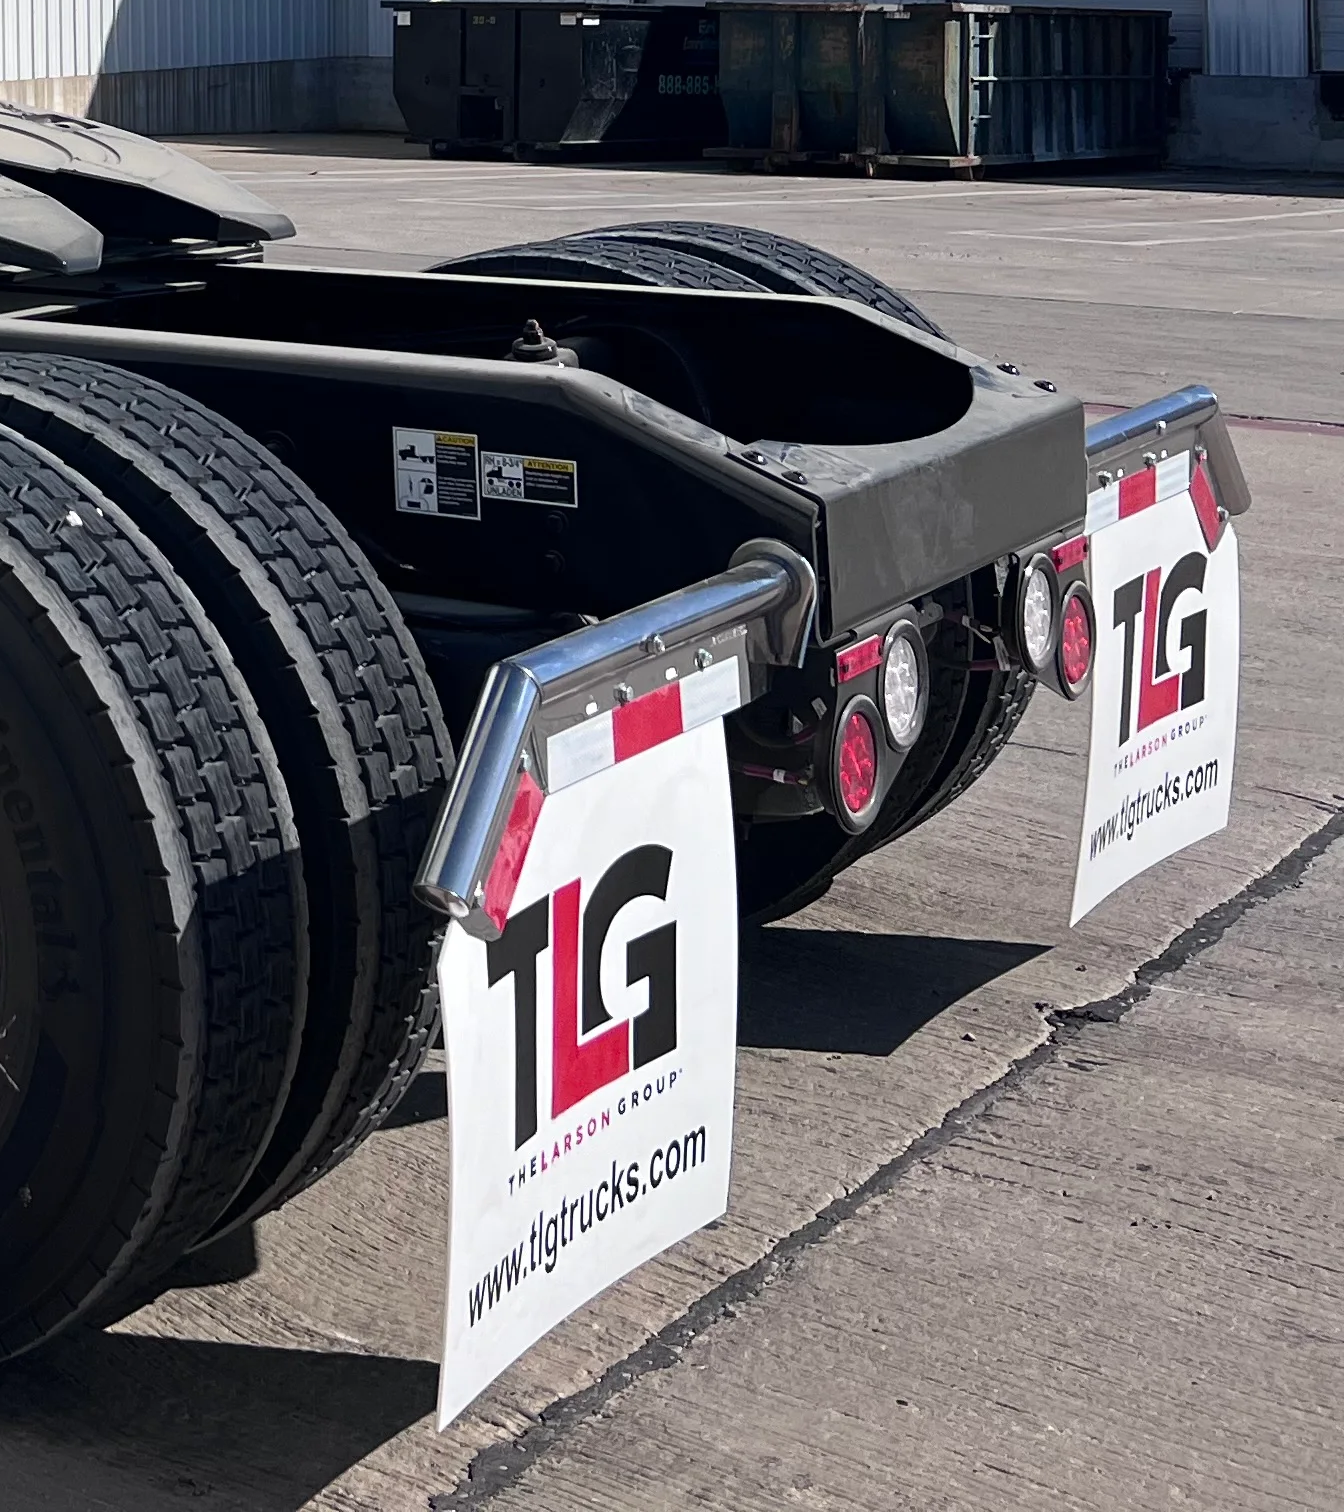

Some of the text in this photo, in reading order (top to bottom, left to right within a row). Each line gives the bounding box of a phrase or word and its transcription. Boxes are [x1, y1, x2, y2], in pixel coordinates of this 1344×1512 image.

[487, 487, 522, 497] UNLADEN
[527, 462, 569, 470] ATTENTION
[1113, 551, 1209, 748] TLG
[1089, 758, 1219, 861] www.tlgtrucks.com
[486, 844, 677, 1151] TLG
[469, 1125, 707, 1328] www.tlgtrucks.com
